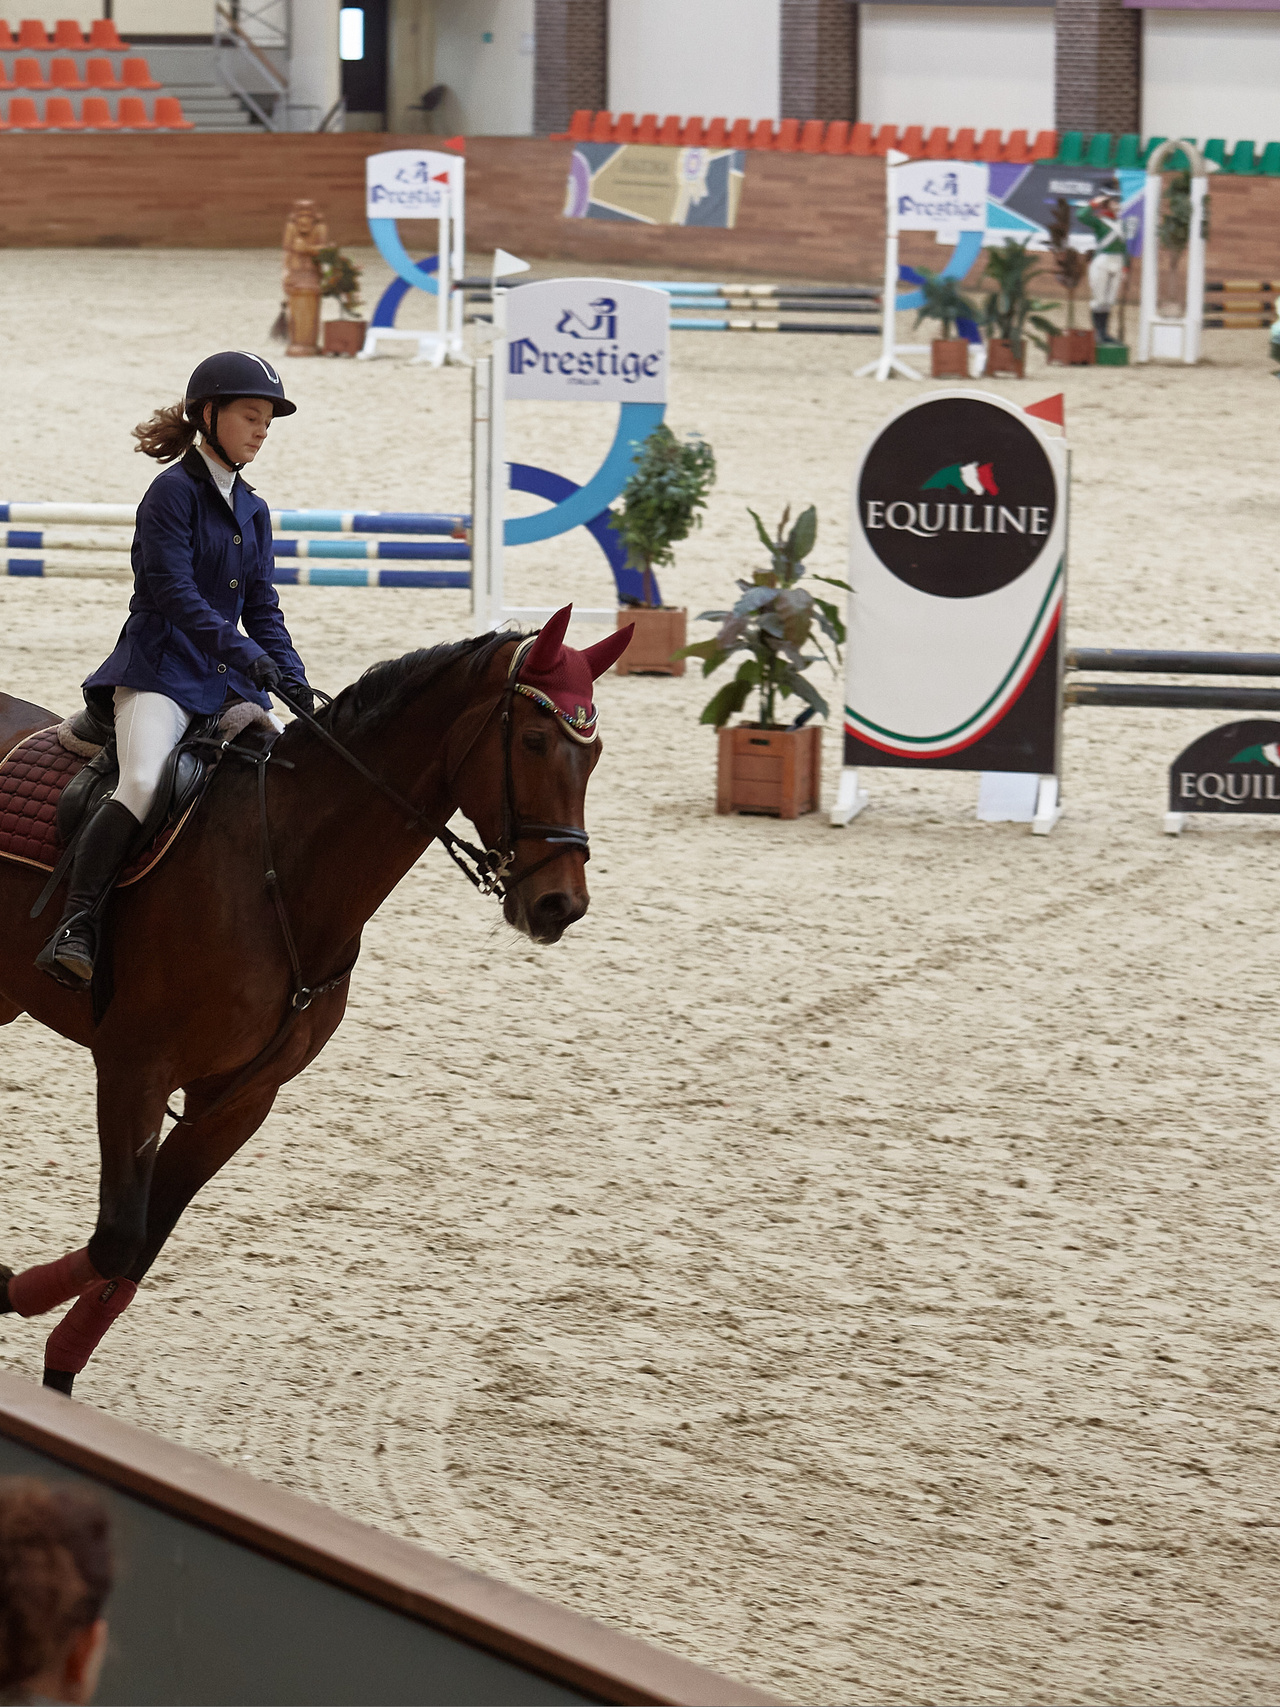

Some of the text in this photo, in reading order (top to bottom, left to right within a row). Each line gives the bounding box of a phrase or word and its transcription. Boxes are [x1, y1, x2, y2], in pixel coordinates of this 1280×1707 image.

[371, 184, 441, 208] Prestig
[508, 337, 661, 384] Prestige
[865, 500, 1050, 538] EQUILINE
[1180, 772, 1280, 805] EQUIL
